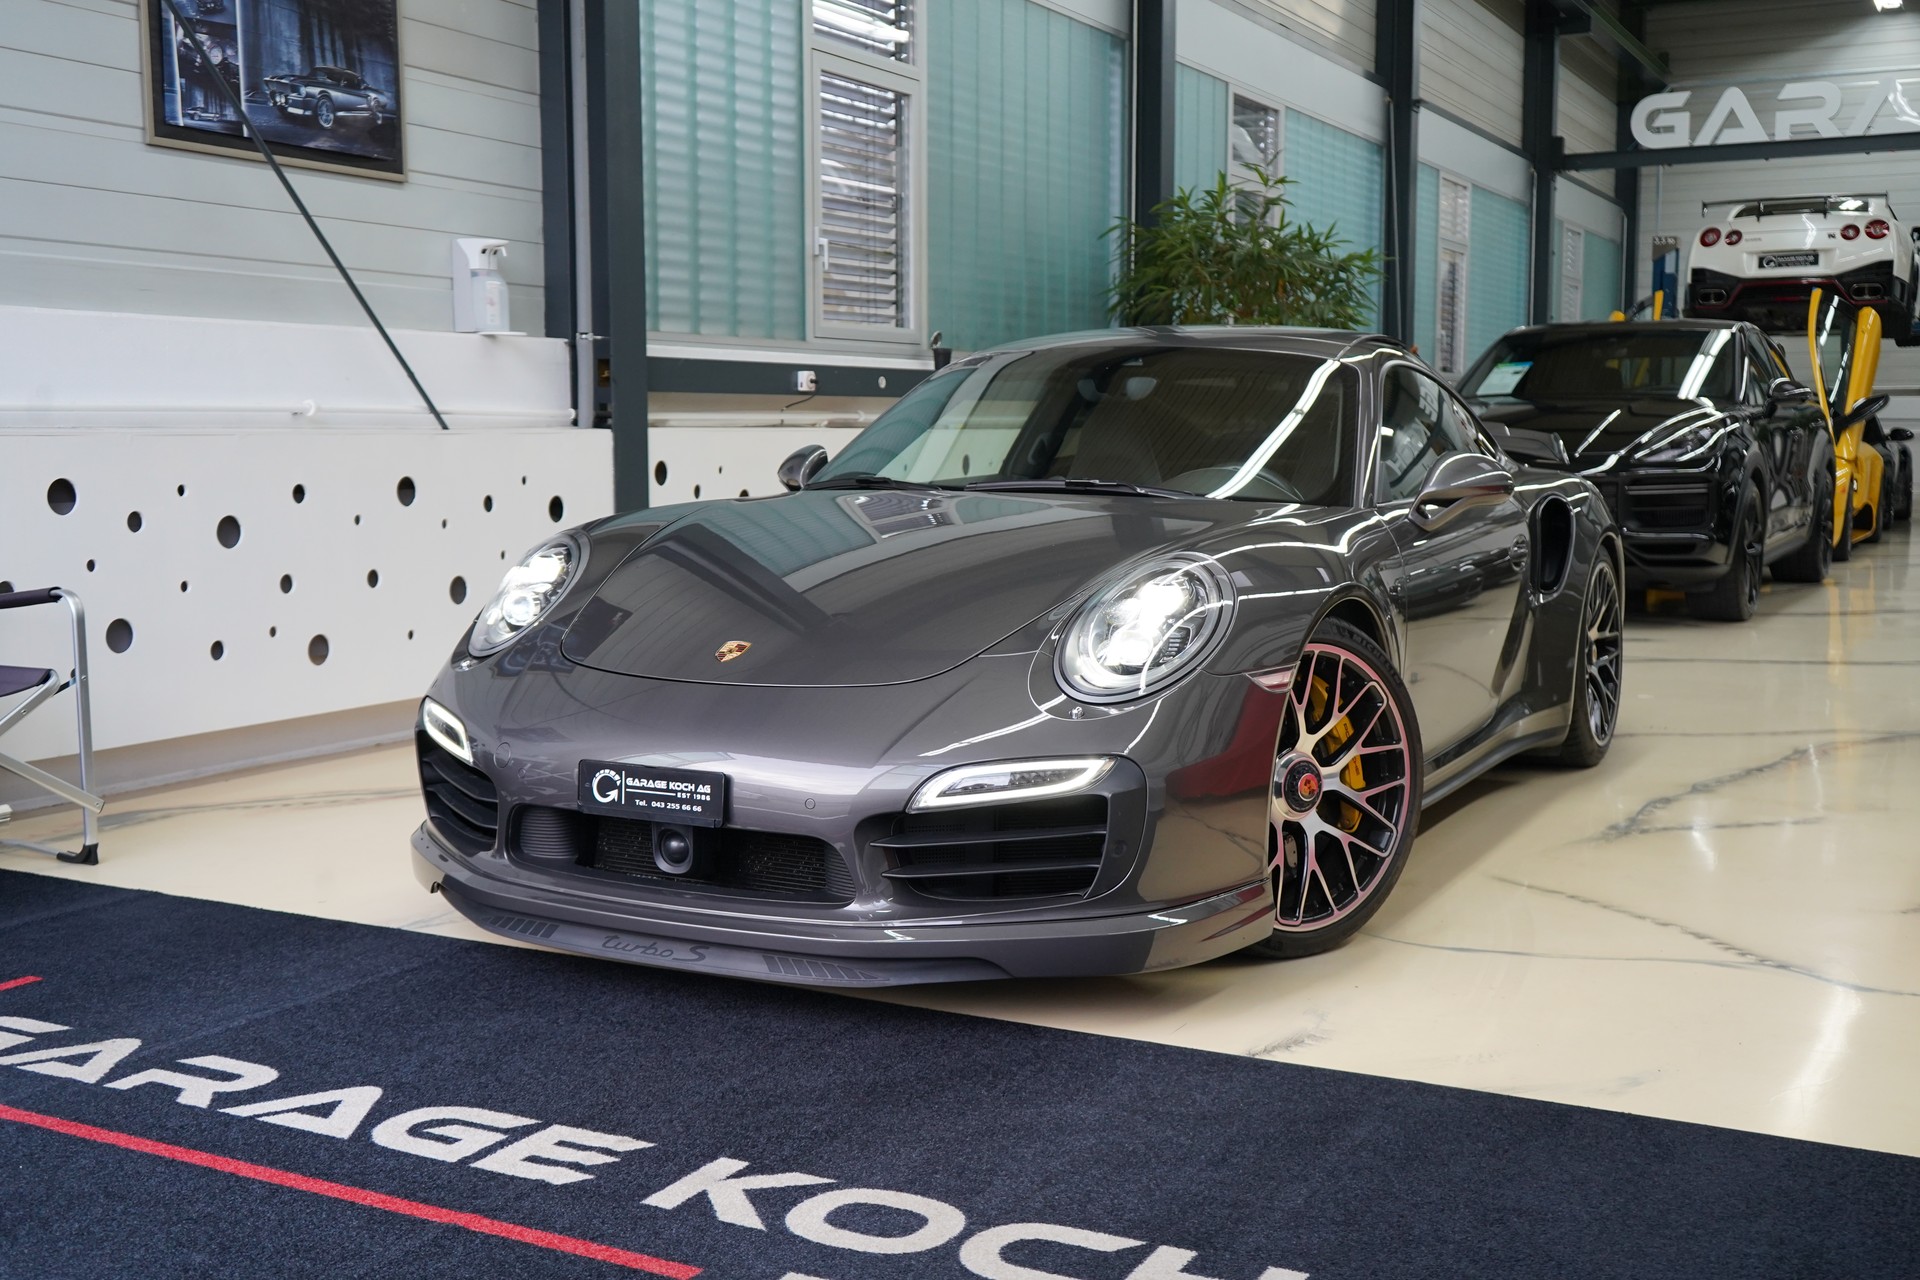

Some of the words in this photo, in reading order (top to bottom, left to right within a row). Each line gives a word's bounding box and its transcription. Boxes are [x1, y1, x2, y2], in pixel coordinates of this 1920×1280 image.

[626, 777, 668, 789] GARAGE
[669, 781, 695, 792] KOCH
[696, 784, 711, 793] AG
[693, 793, 711, 801] 1986
[635, 799, 648, 807] Tel.
[666, 802, 680, 810] 255
[601, 934, 674, 958] turbo
[672, 945, 710, 962] S
